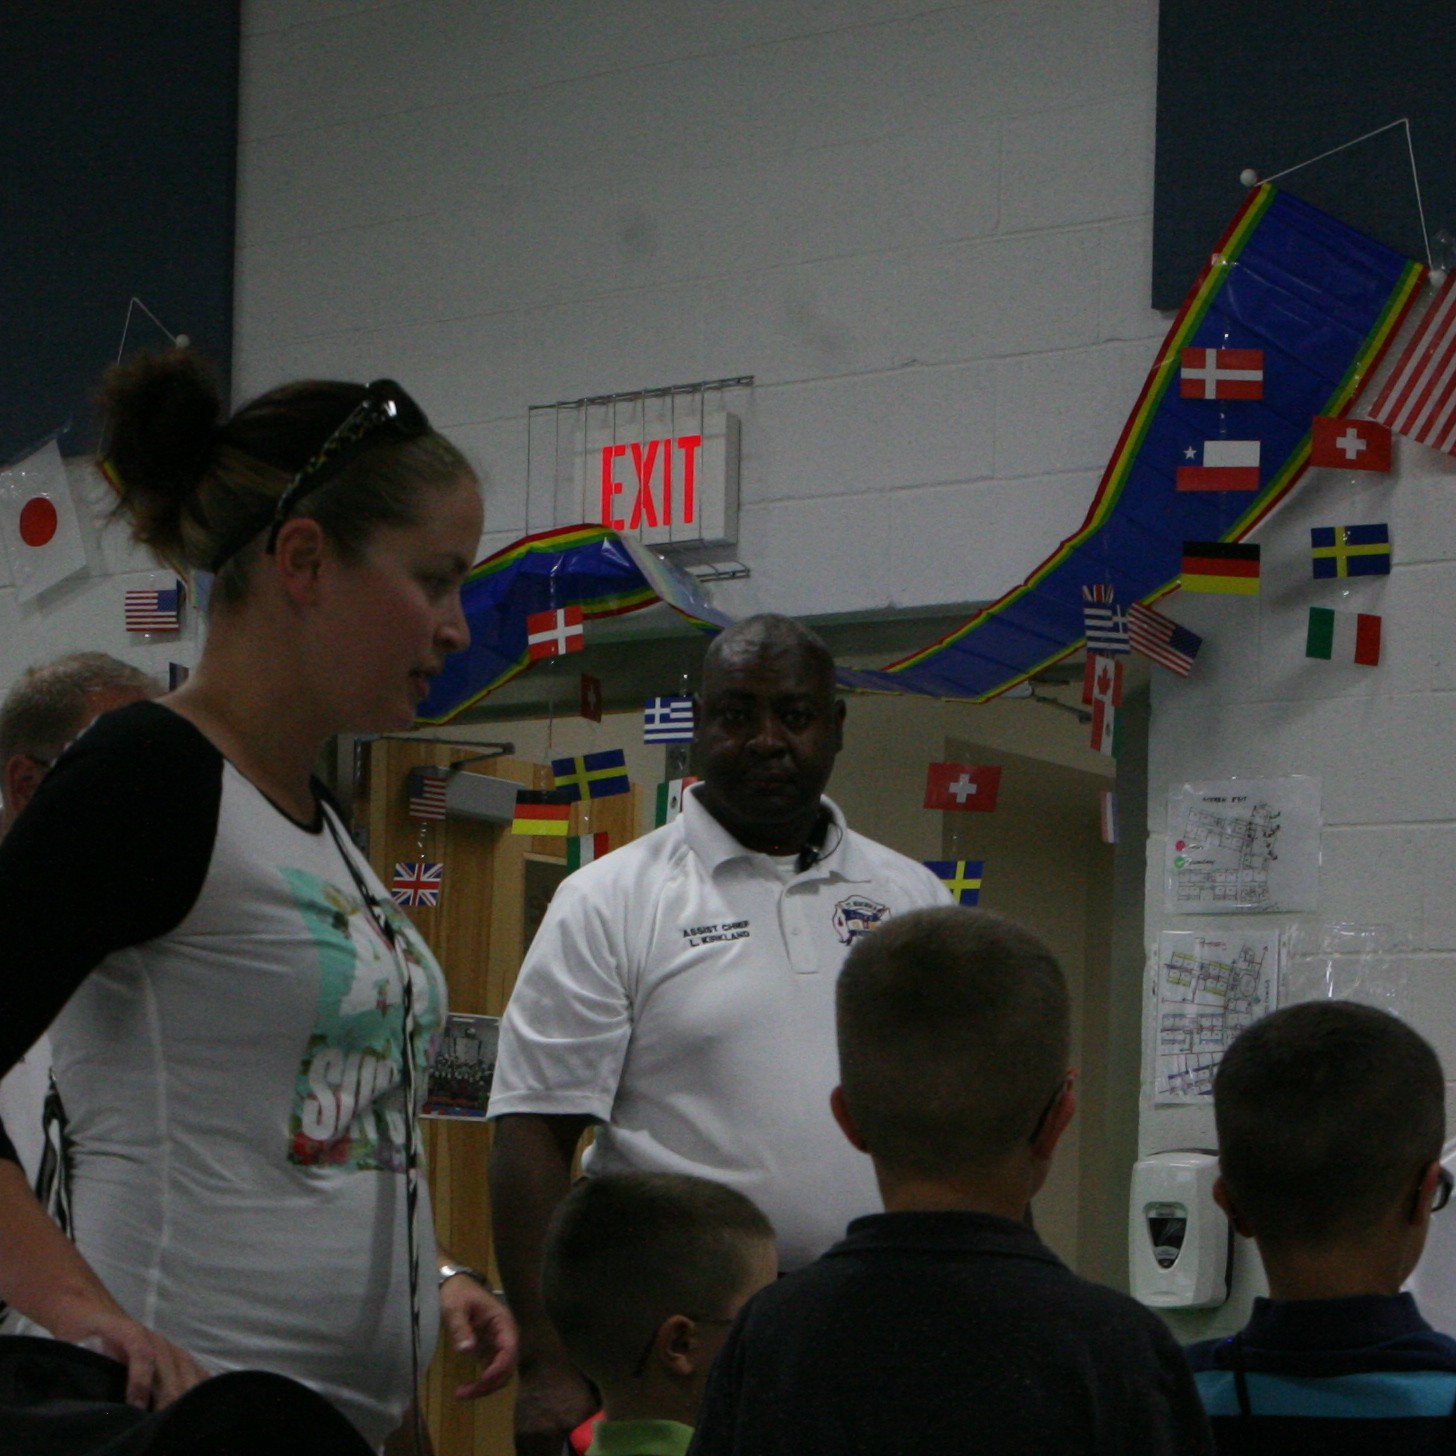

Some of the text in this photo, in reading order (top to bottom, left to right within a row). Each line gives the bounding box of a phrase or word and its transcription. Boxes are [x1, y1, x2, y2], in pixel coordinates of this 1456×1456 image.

[600, 433, 703, 531] EXIT
[683, 920, 750, 938] ASSIST CHIEF
